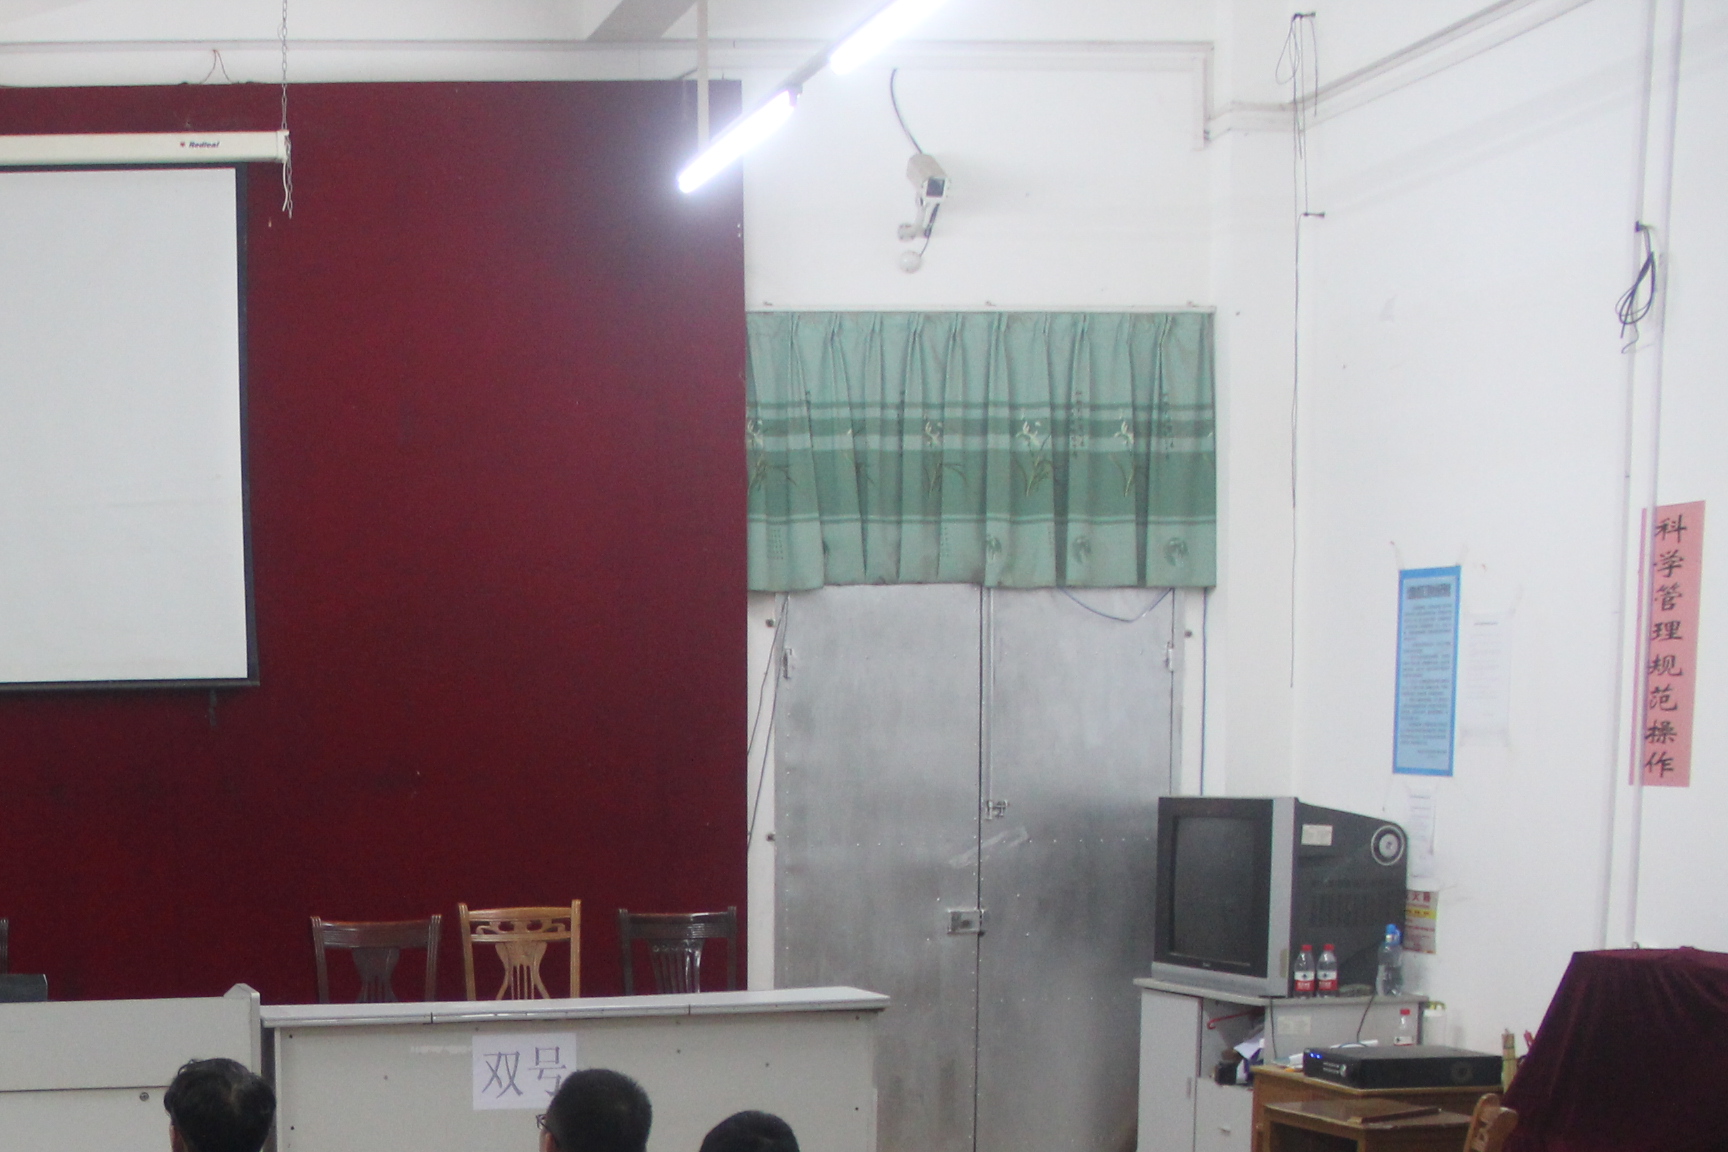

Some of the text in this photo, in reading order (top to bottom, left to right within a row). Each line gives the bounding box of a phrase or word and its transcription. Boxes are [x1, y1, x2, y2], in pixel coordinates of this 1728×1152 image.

[1644, 513, 1688, 779] 科学管理规范操作
[482, 1046, 567, 1099] 双号
